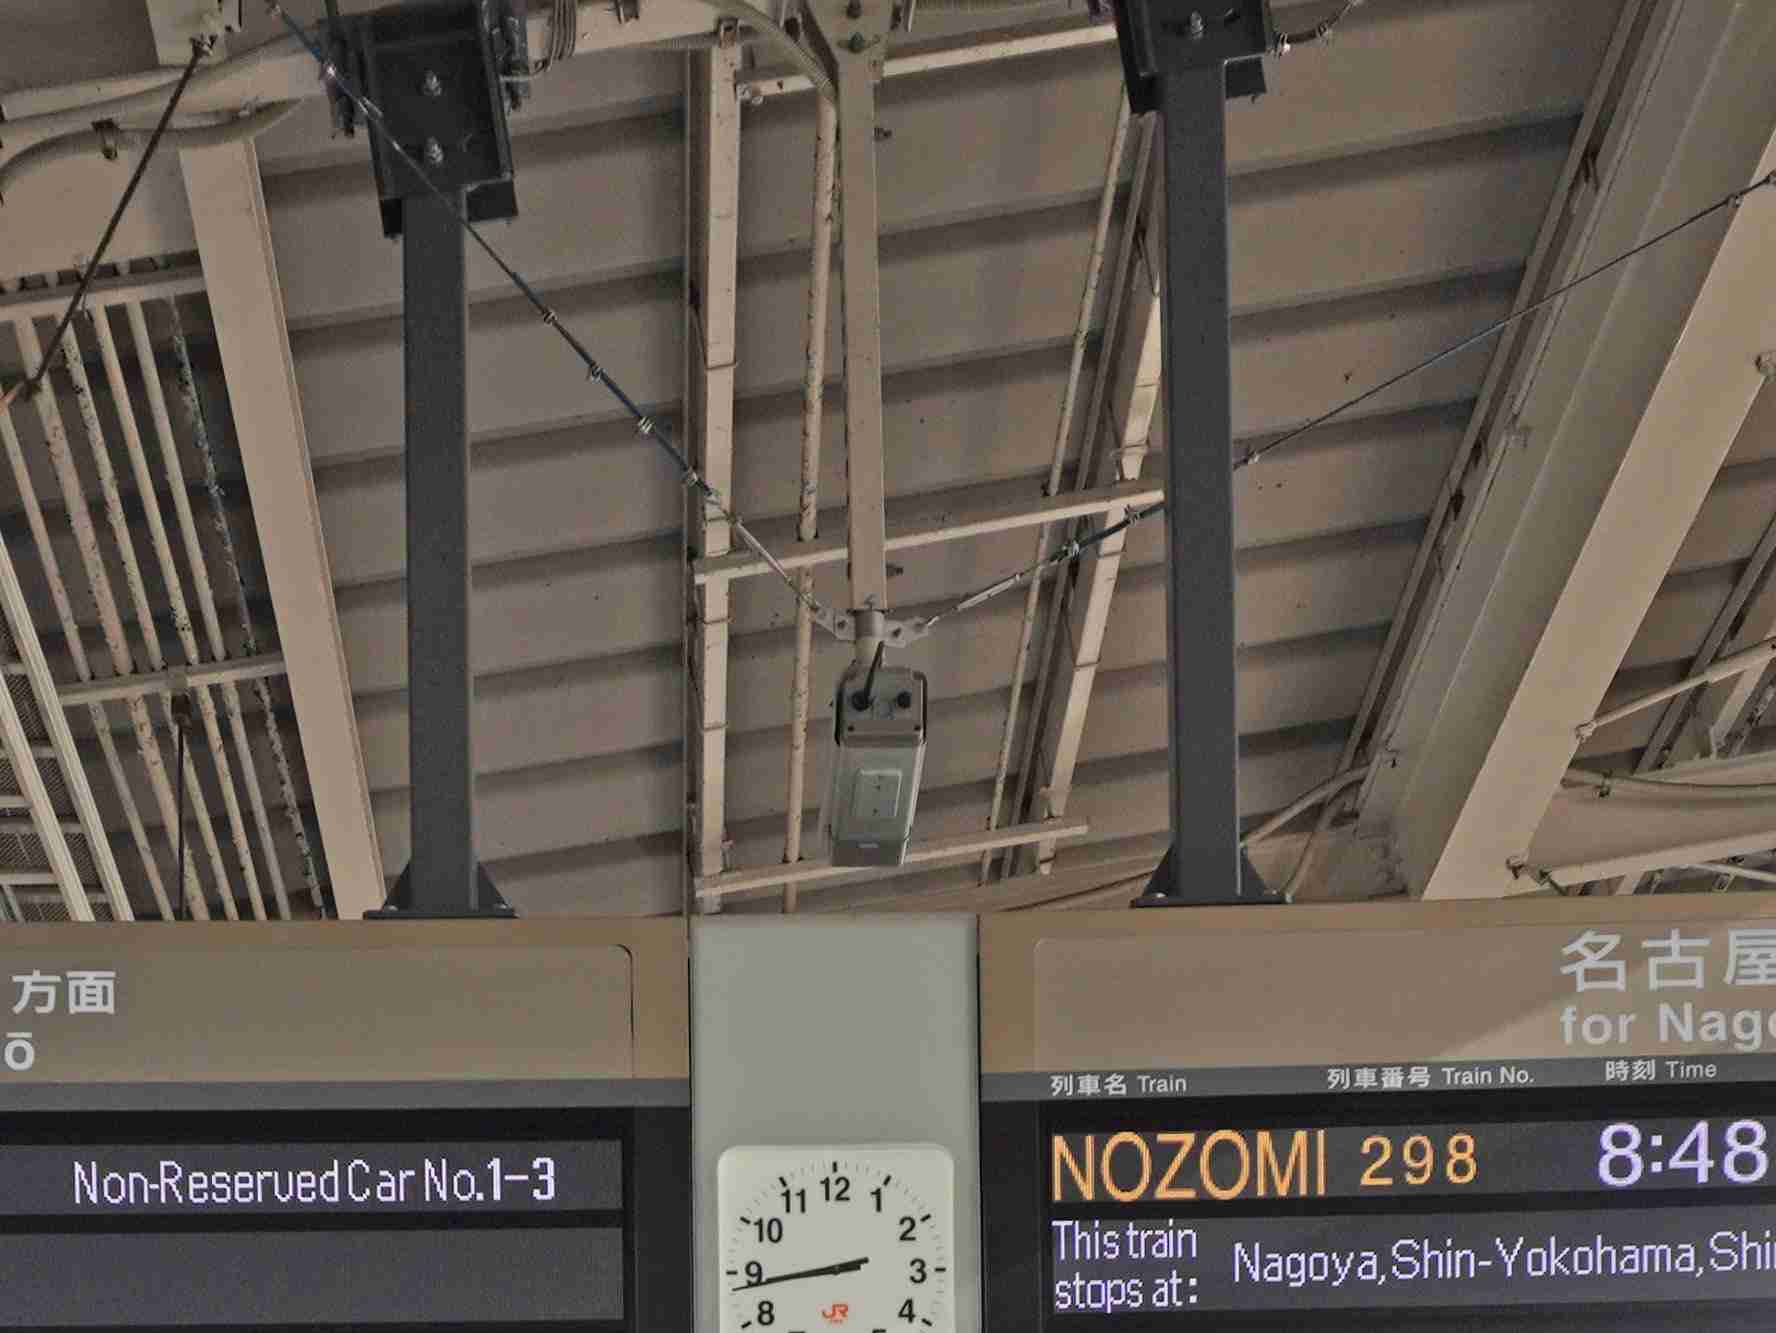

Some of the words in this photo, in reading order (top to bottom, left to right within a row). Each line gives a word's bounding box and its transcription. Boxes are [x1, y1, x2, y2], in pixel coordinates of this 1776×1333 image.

[1560, 1004, 1632, 1045] for
[1327, 1066, 1431, 1090] 列車番号
[1442, 1067, 1494, 1087] Train
[1499, 1066, 1535, 1085] No.
[1605, 1058, 1655, 1082] 時刻
[1664, 1060, 1718, 1080] Time
[1050, 1073, 1128, 1097] 列車名
[1136, 1074, 1187, 1094] Train
[1052, 1130, 1326, 1203] NOZOMI
[1361, 1135, 1478, 1187] 298
[1598, 1121, 1770, 1188] 8:48
[347, 1159, 414, 1202] Car
[820, 1177, 850, 1201] 12
[781, 1189, 806, 1212] 11
[871, 1188, 881, 1211] 1
[754, 1218, 783, 1242] 10
[899, 1217, 916, 1241] 2
[1053, 1220, 1121, 1261] This
[1125, 1220, 1197, 1258] train
[745, 1261, 762, 1286] 9
[910, 1259, 926, 1283] 3
[1055, 1273, 1144, 1314] stops
[1153, 1272, 1198, 1307] at:
[757, 1301, 774, 1325] 8
[898, 1299, 915, 1322] 4
